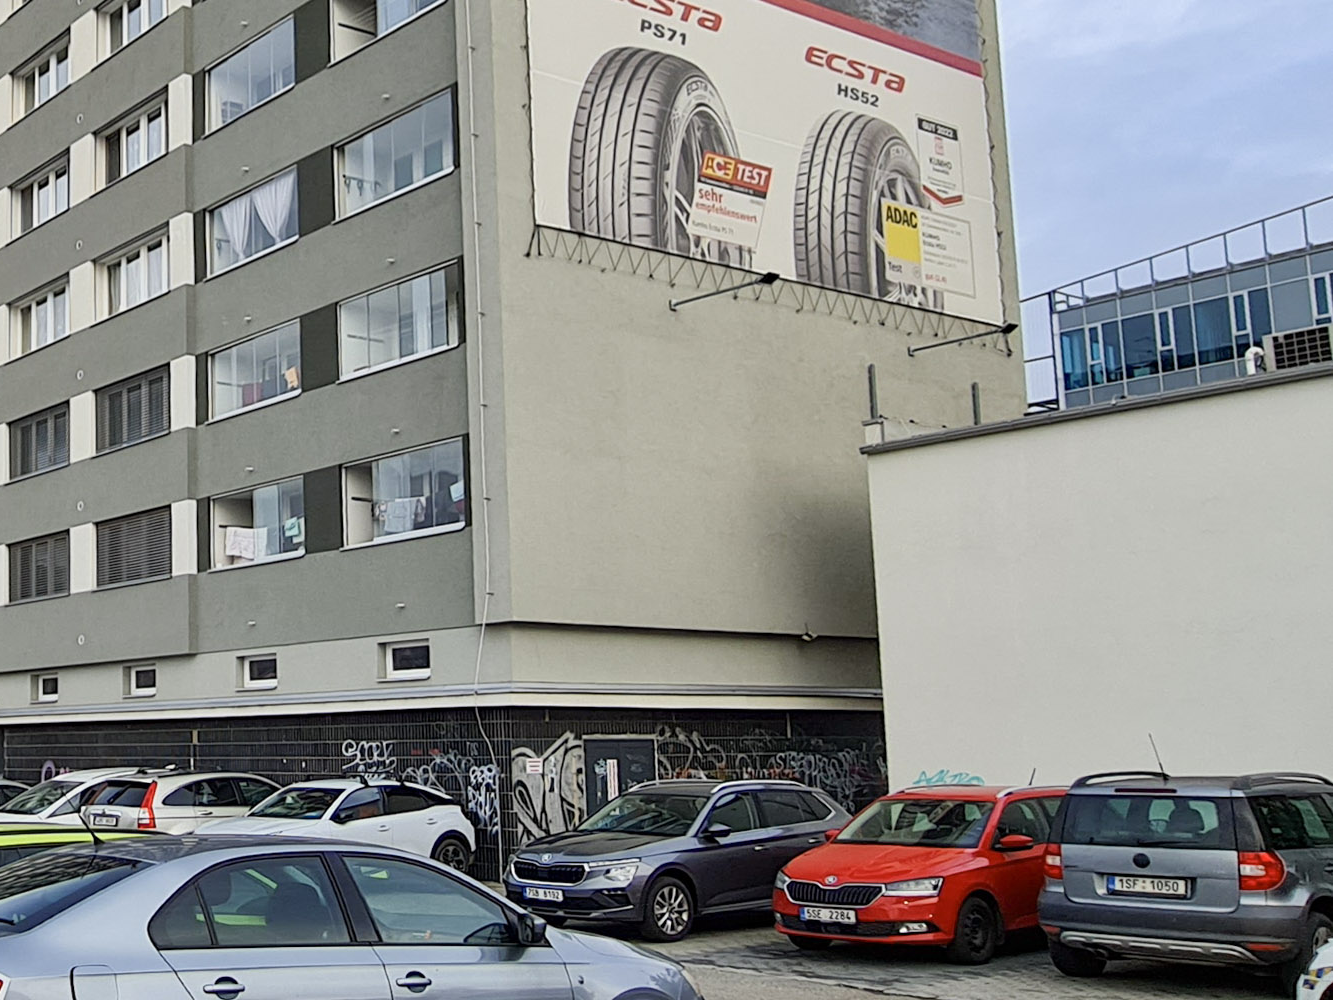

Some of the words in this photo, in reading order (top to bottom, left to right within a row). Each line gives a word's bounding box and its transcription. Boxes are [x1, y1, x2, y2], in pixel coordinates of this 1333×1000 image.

[640, 19, 687, 46] PS71
[837, 83, 880, 108] HS52
[736, 164, 769, 187] TEST
[698, 187, 724, 203] sehr
[886, 205, 918, 229] ADAC
[888, 261, 903, 274] Test
[1119, 879, 1139, 889] 1SF
[1150, 880, 1179, 892] 1050
[807, 909, 822, 919] 5SE
[829, 911, 852, 920] 2284
